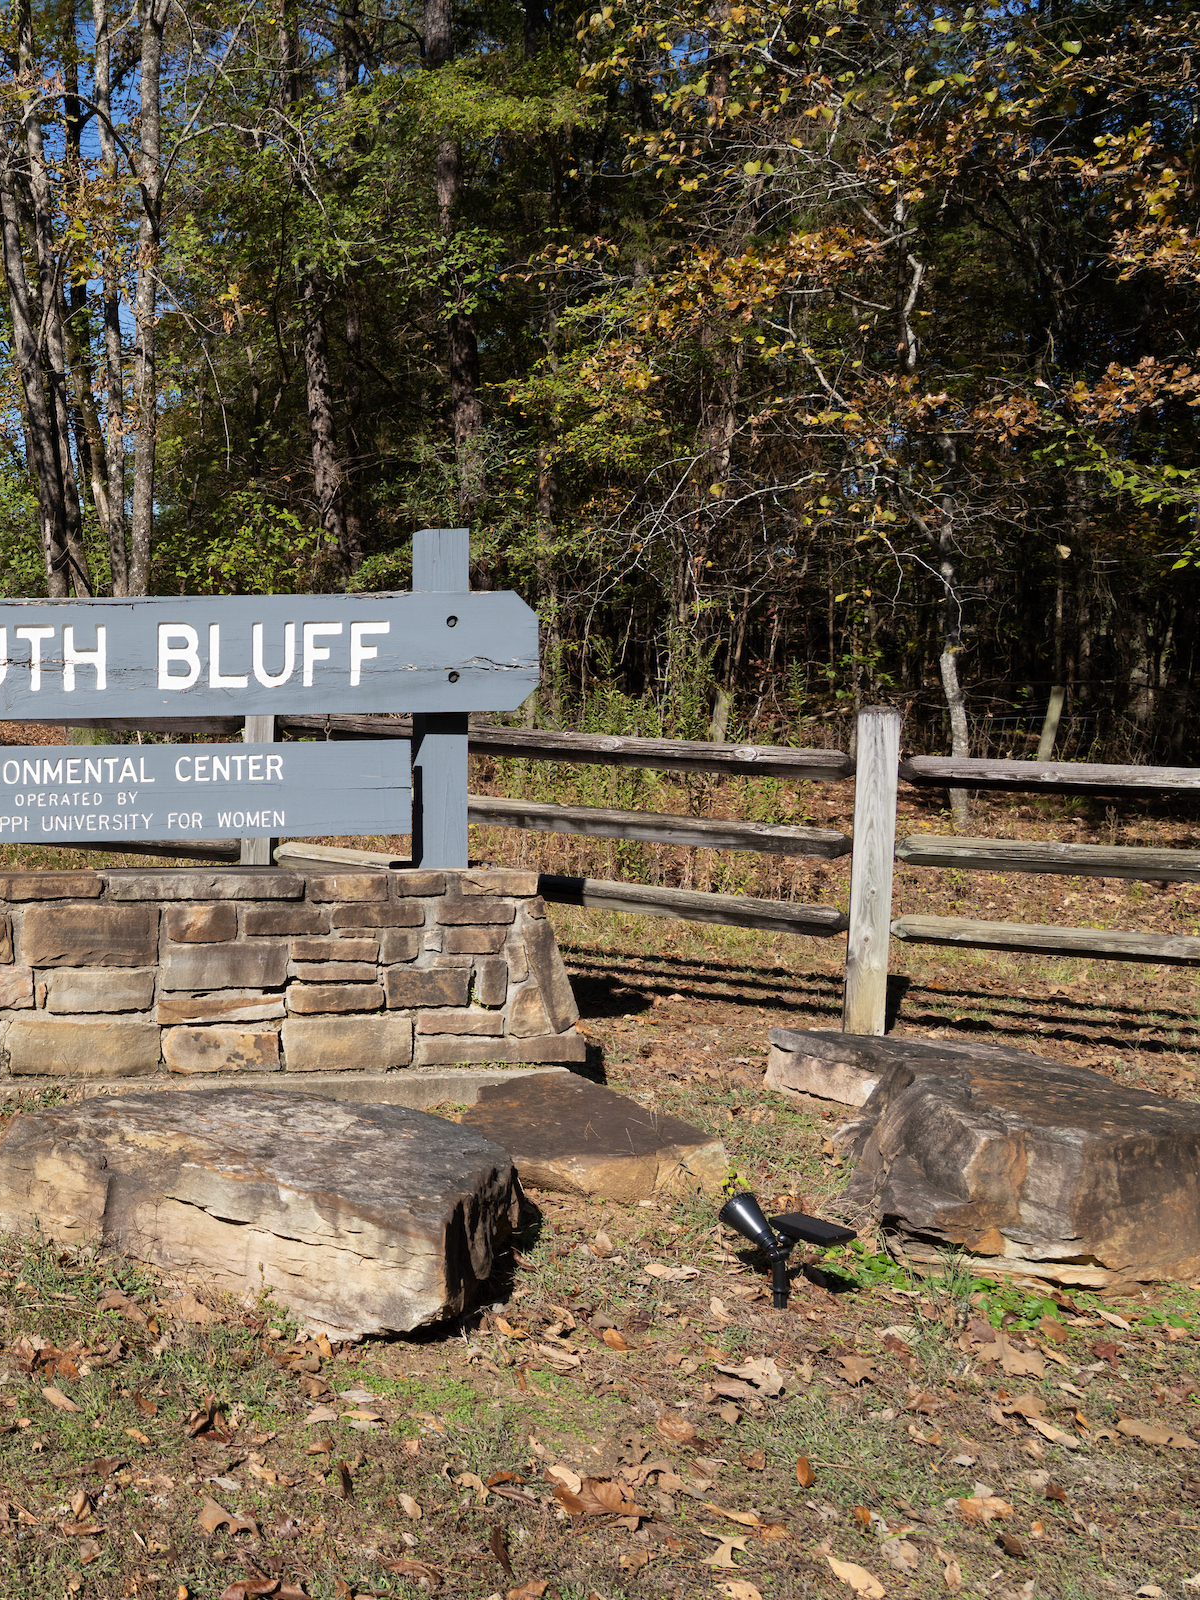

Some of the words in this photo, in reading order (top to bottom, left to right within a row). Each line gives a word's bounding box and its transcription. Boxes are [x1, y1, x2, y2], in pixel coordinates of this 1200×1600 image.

[156, 620, 391, 691] BLUFF
[174, 754, 284, 783] CENTER
[14, 791, 103, 808] OPERATED
[117, 790, 138, 806] BY
[41, 813, 154, 832] UNIVERSITY
[167, 811, 203, 830] FOR
[217, 810, 286, 829] WOMEN
